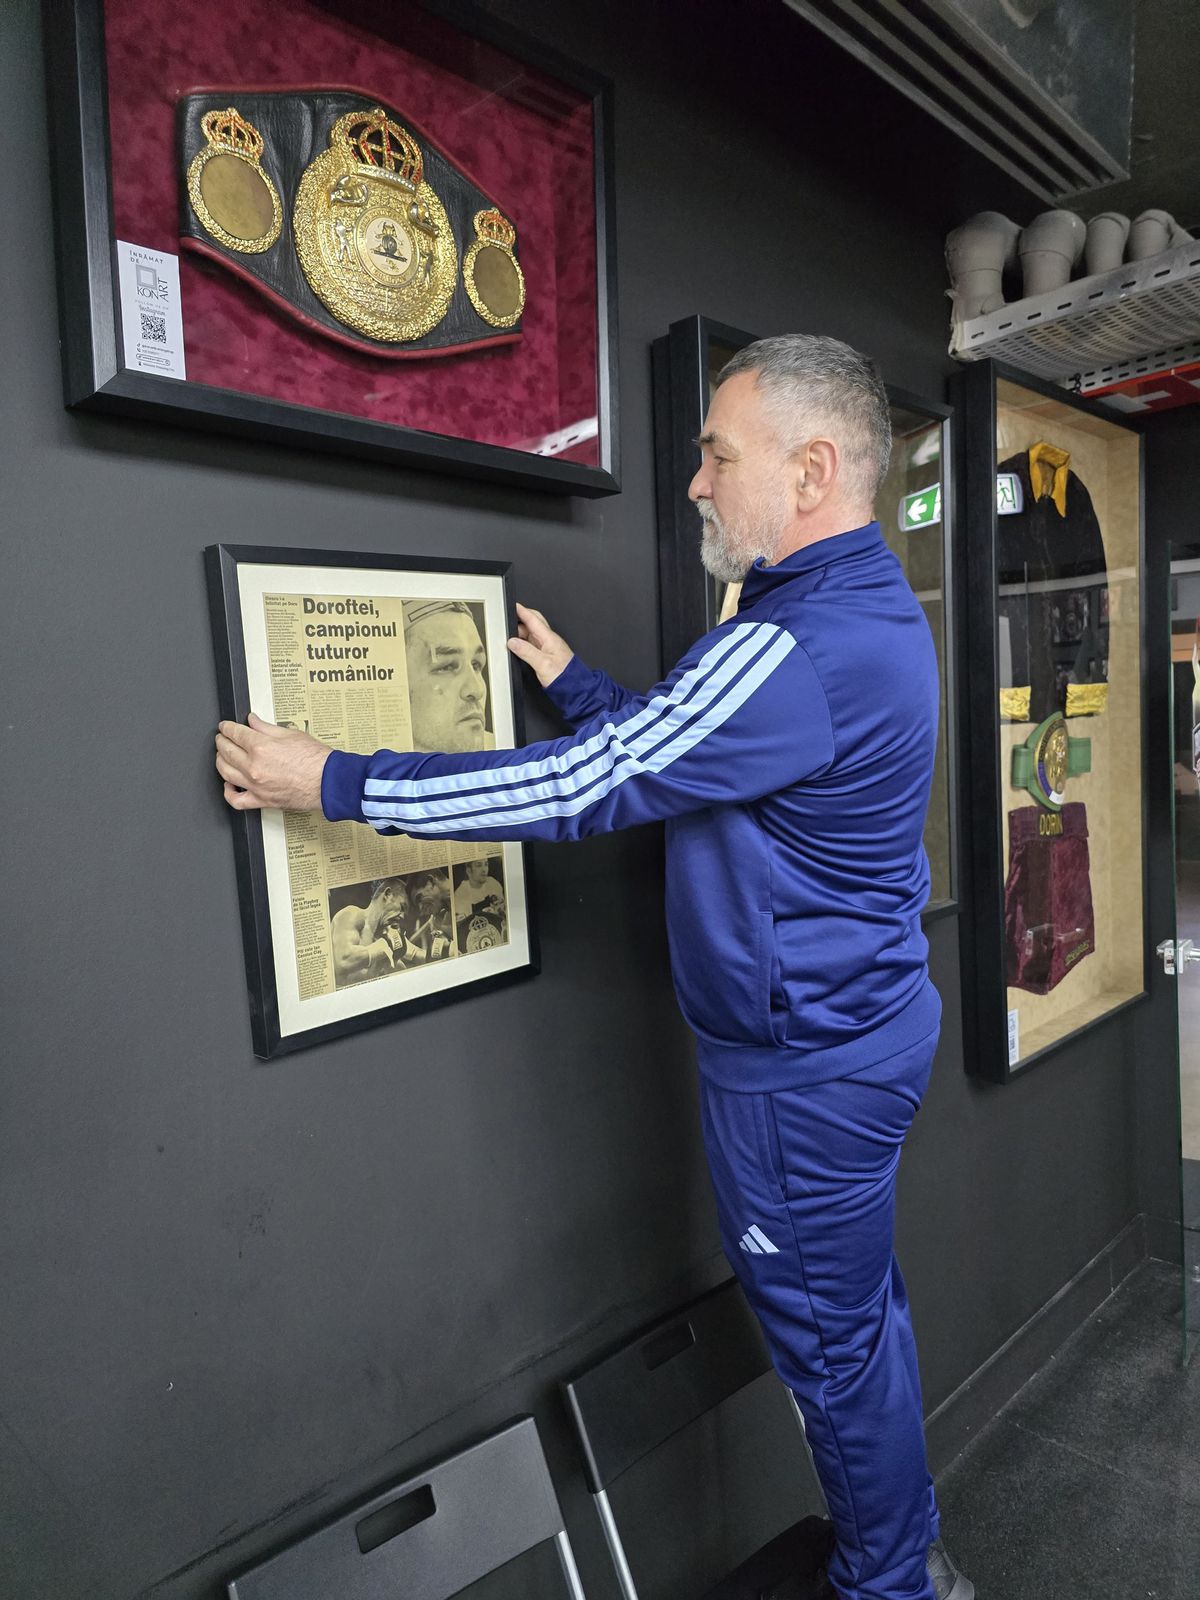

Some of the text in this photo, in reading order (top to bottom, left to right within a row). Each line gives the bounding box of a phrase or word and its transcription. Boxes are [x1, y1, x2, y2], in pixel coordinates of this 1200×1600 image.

[136, 286, 158, 300] KON
[158, 276, 169, 302] ART
[303, 598, 380, 618] Doroftei,
[305, 621, 397, 641] campionul
[307, 644, 369, 660] tuturor
[309, 664, 394, 682] românilor
